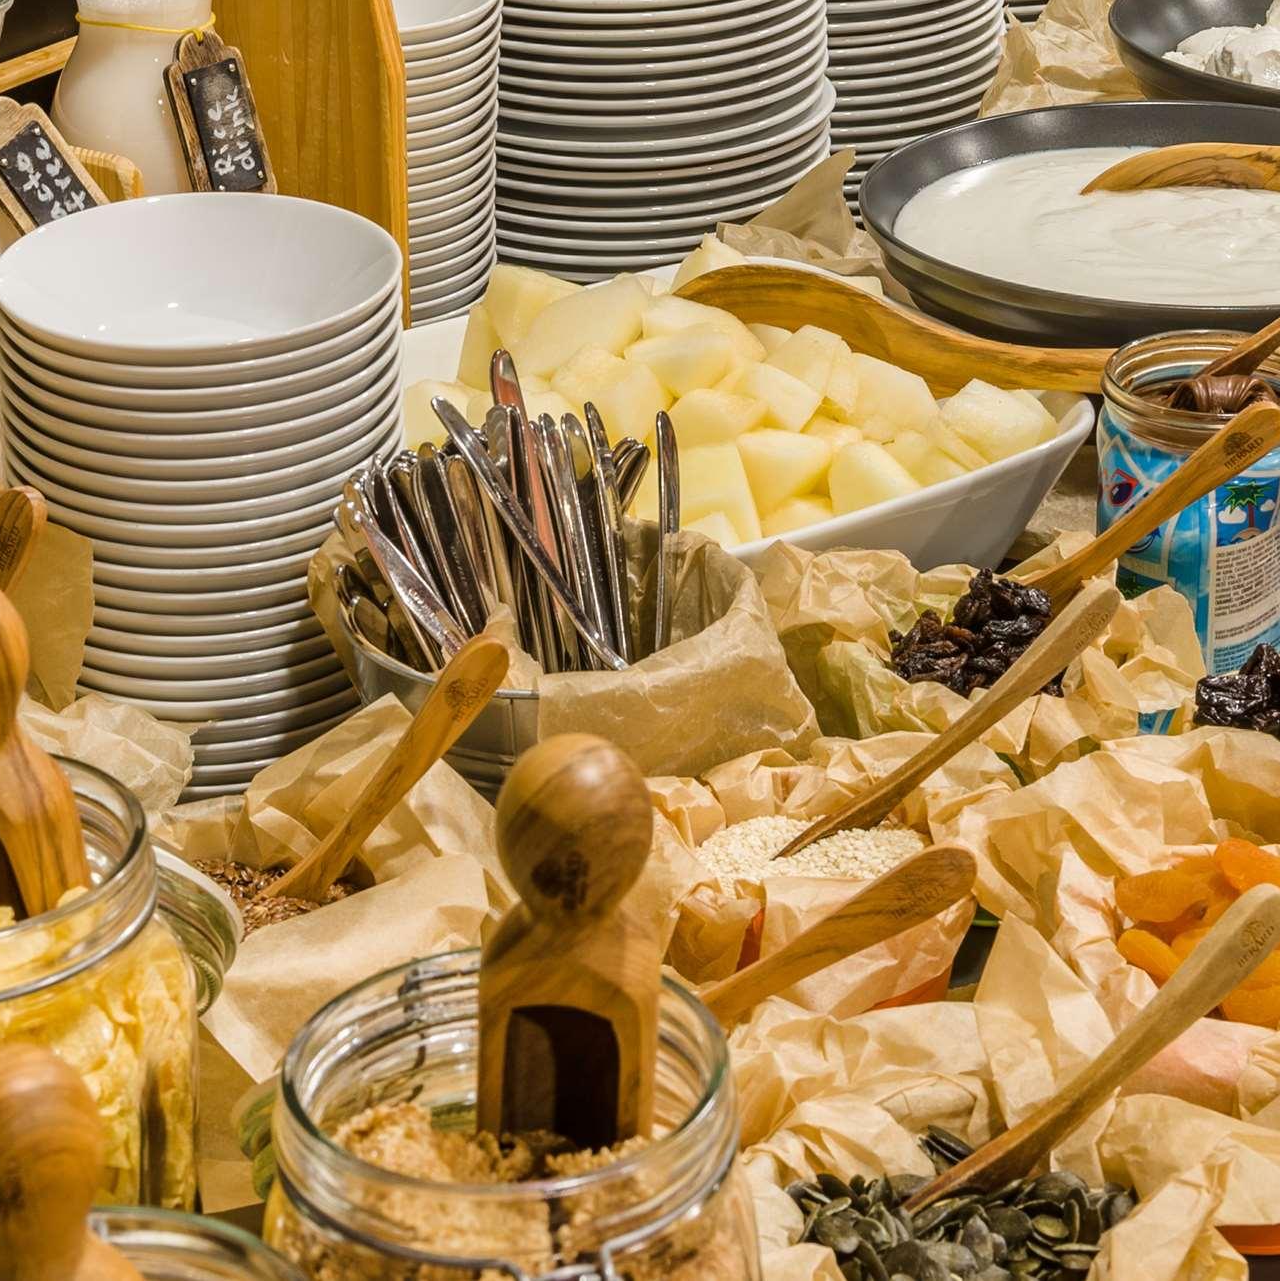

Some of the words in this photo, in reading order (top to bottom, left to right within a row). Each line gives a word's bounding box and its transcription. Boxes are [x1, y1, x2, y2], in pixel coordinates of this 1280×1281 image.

[207, 100, 236, 176] Rice
[223, 85, 256, 171] drink
[15, 151, 68, 220] acto
